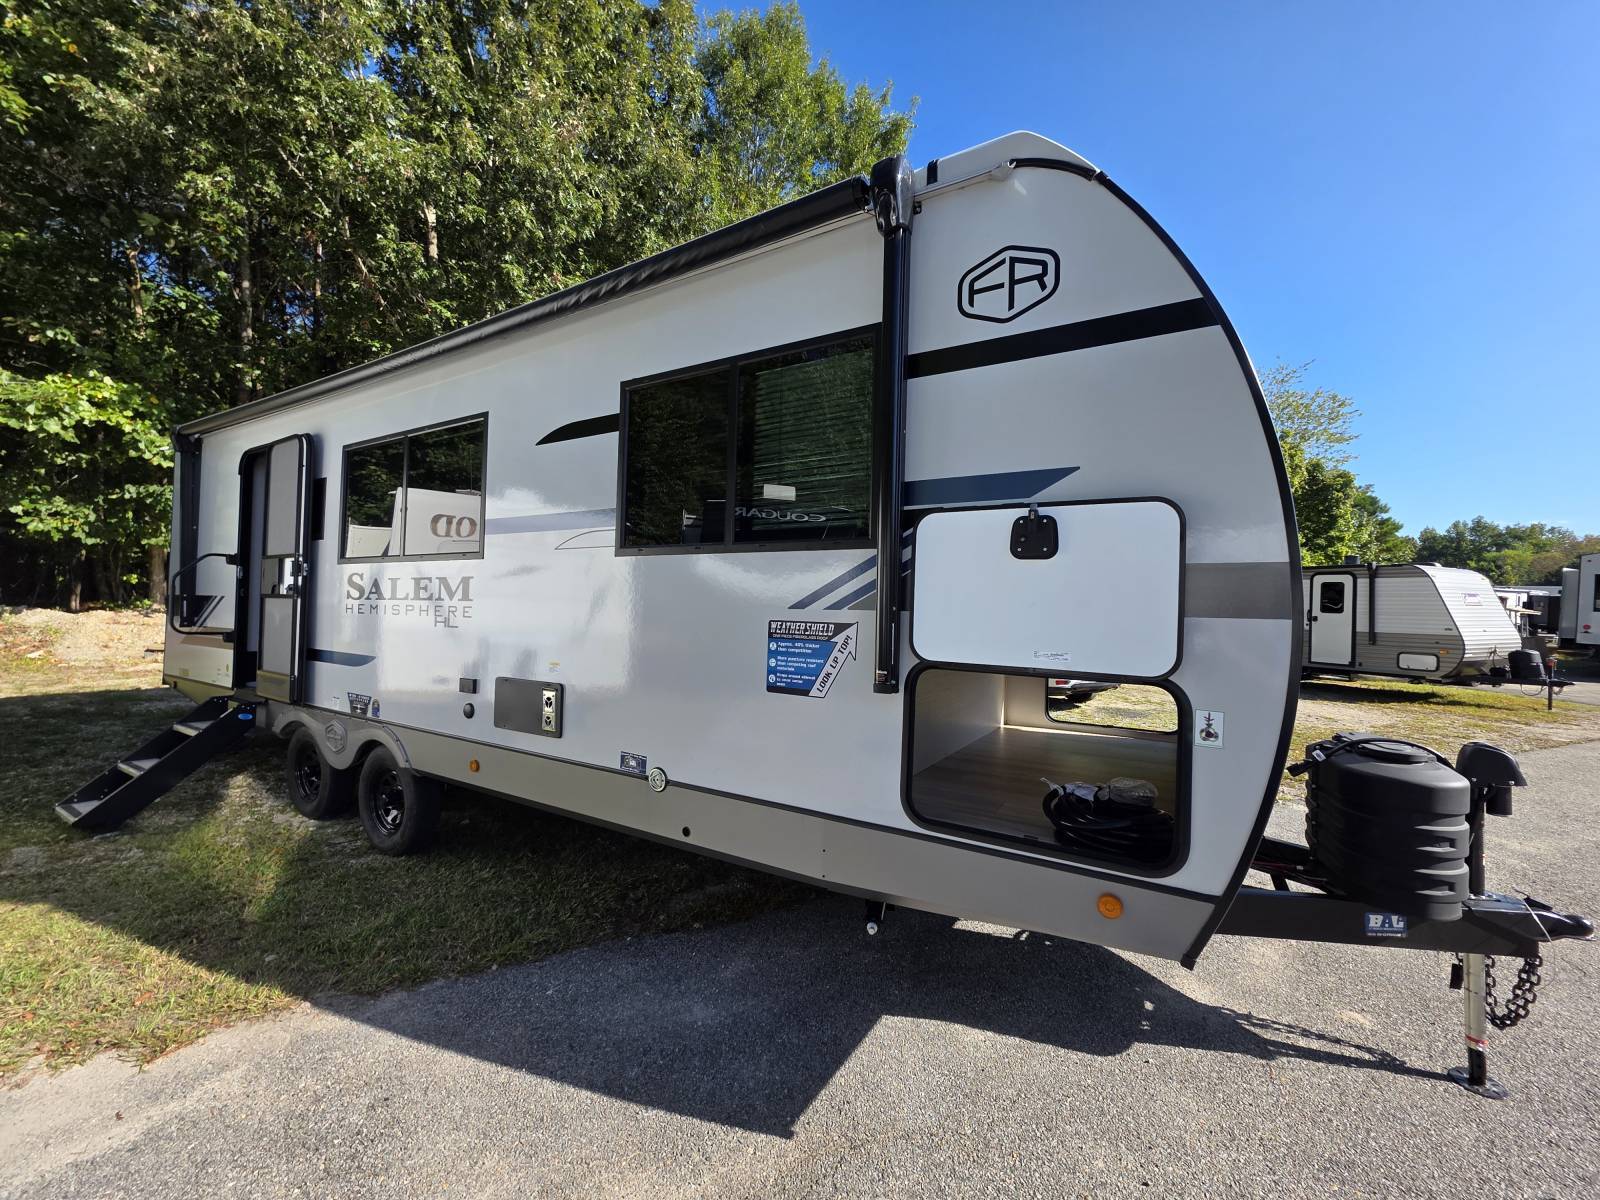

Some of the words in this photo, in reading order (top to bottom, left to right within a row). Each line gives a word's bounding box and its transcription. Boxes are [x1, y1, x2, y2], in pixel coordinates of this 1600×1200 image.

[968, 256, 1049, 312] FR
[346, 572, 474, 602] SALEM
[345, 603, 473, 619] HEMISPHERE
[817, 670, 833, 693] LOOK
[829, 655, 840, 670] UP
[838, 634, 853, 655] TOP!
